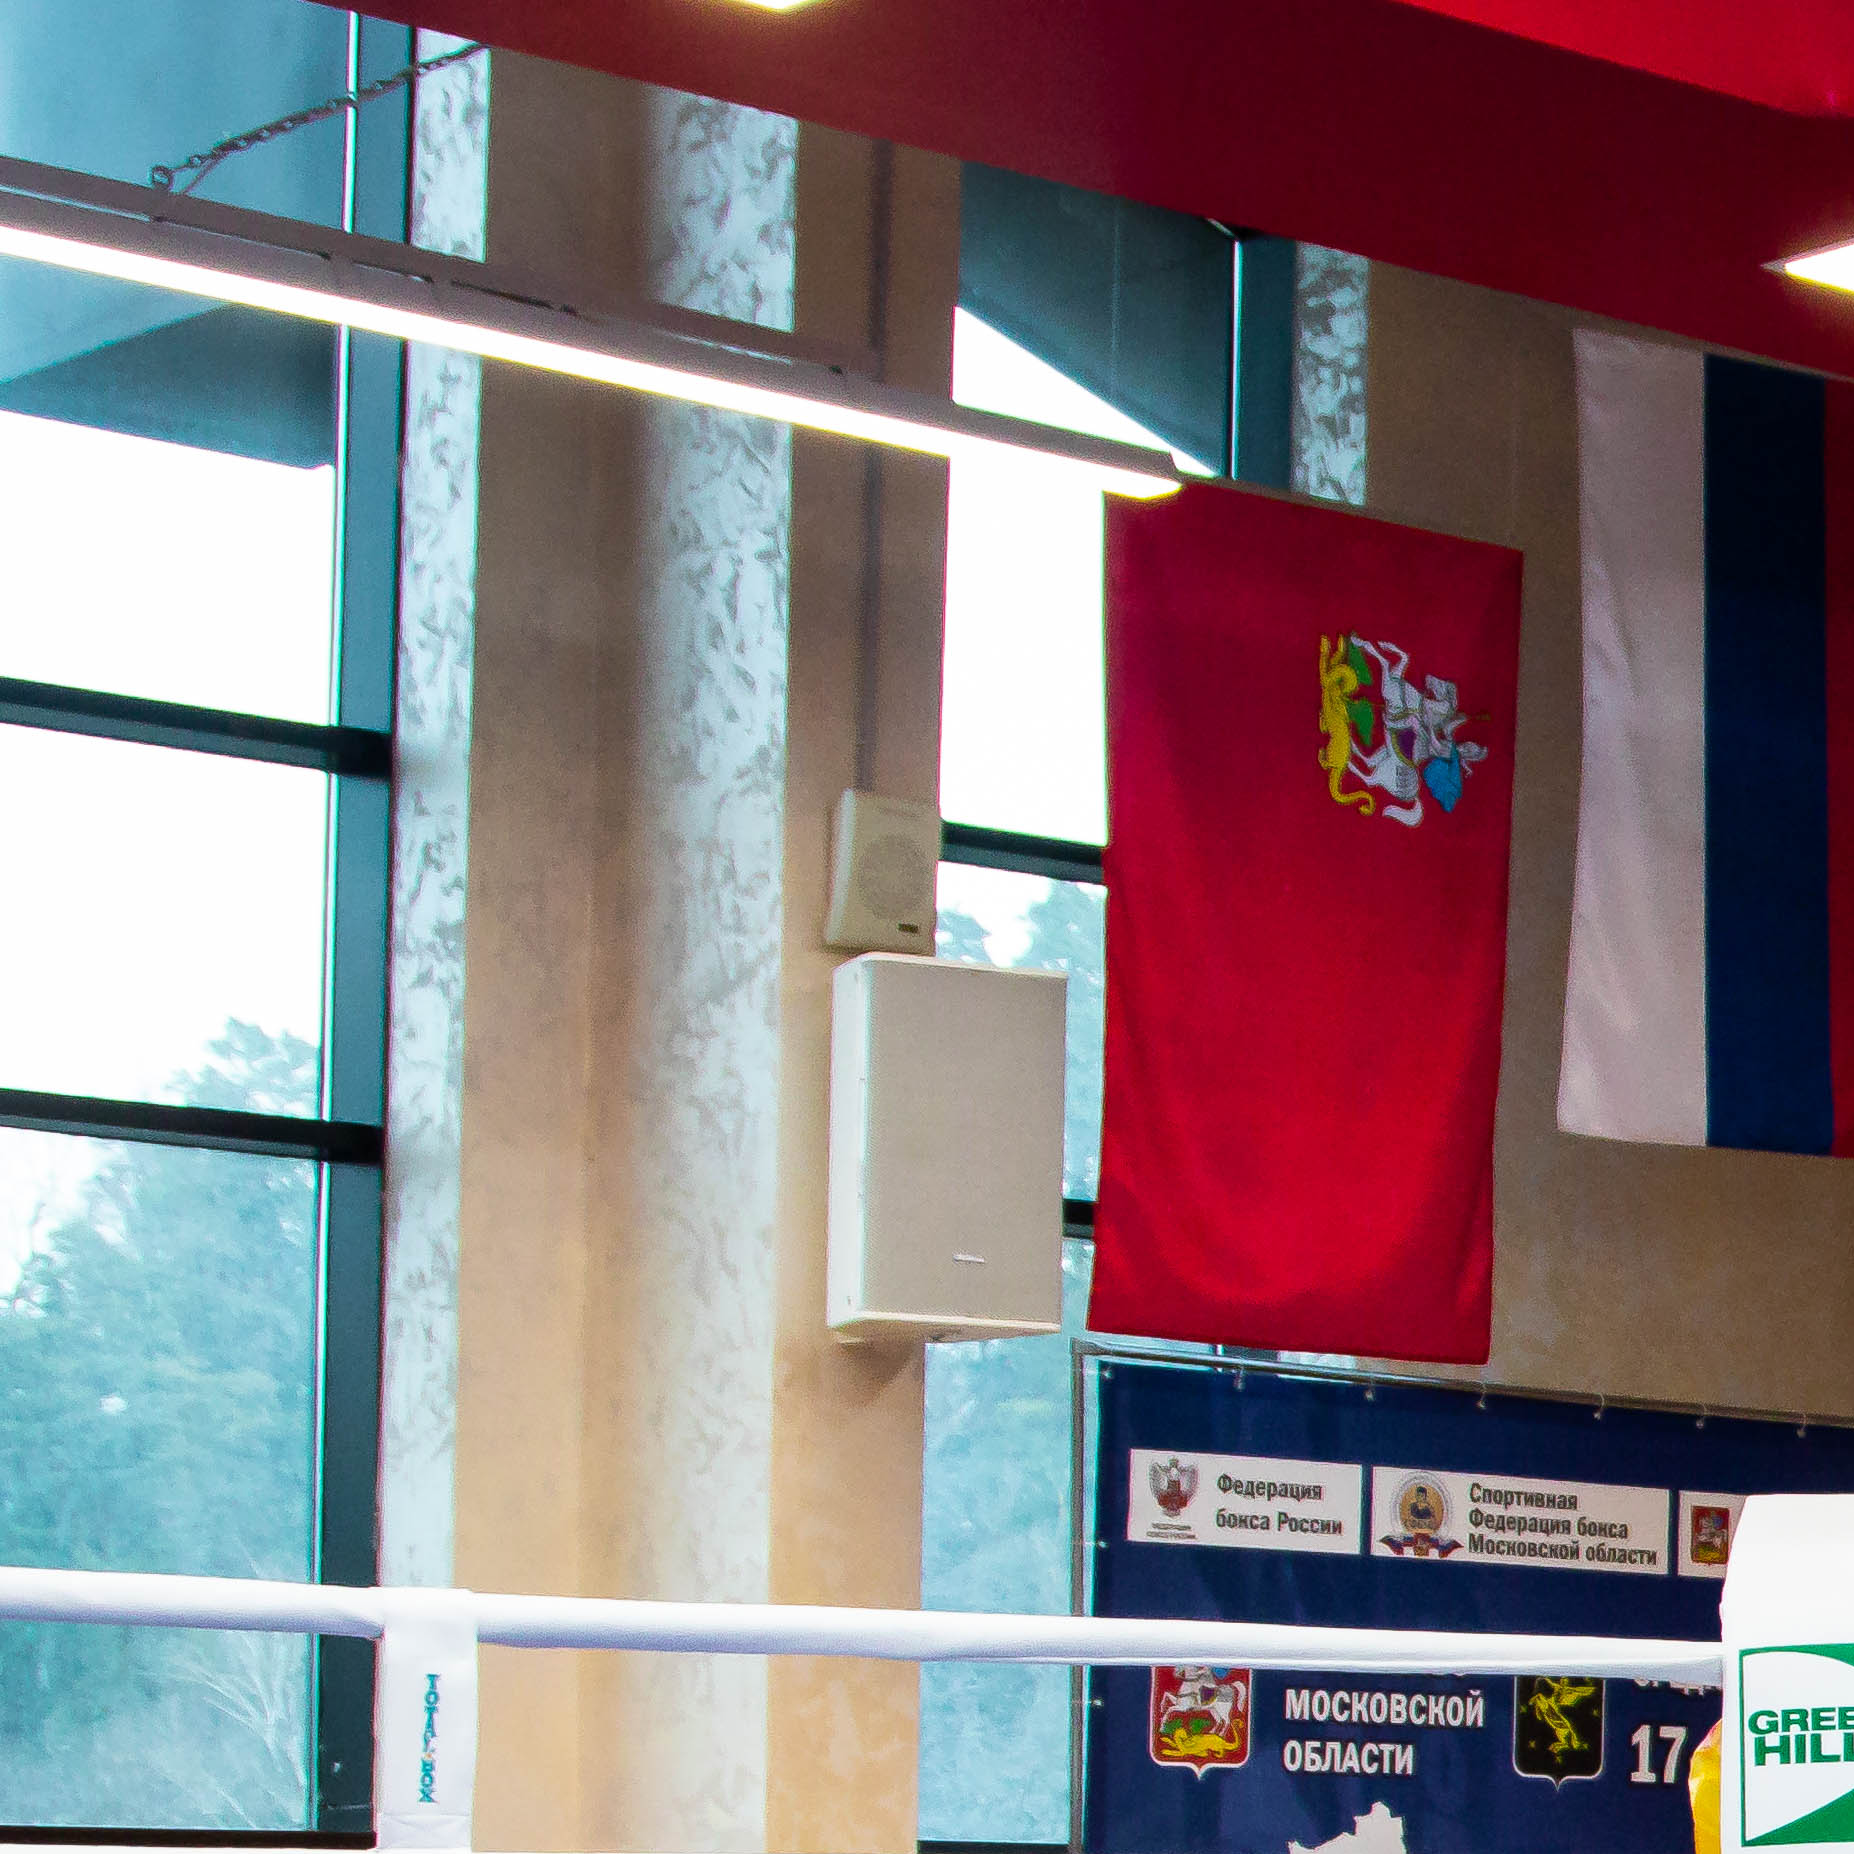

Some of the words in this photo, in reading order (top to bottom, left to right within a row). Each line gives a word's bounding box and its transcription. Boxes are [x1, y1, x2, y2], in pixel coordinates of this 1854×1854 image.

[1217, 1473, 1323, 1502] Федерация
[1469, 1482, 1578, 1512] Спортивная
[1216, 1508, 1270, 1532] бокса
[1277, 1512, 1343, 1537] России
[1469, 1508, 1571, 1537] Федерация
[1577, 1513, 1628, 1540] бокса
[1469, 1533, 1580, 1560] Московской
[1586, 1538, 1658, 1567] области
[1284, 1687, 1484, 1728] МОСКОВСКОЙ
[1283, 1741, 1414, 1775] ОБЛАСТИ
[1630, 1724, 1688, 1784] 17
